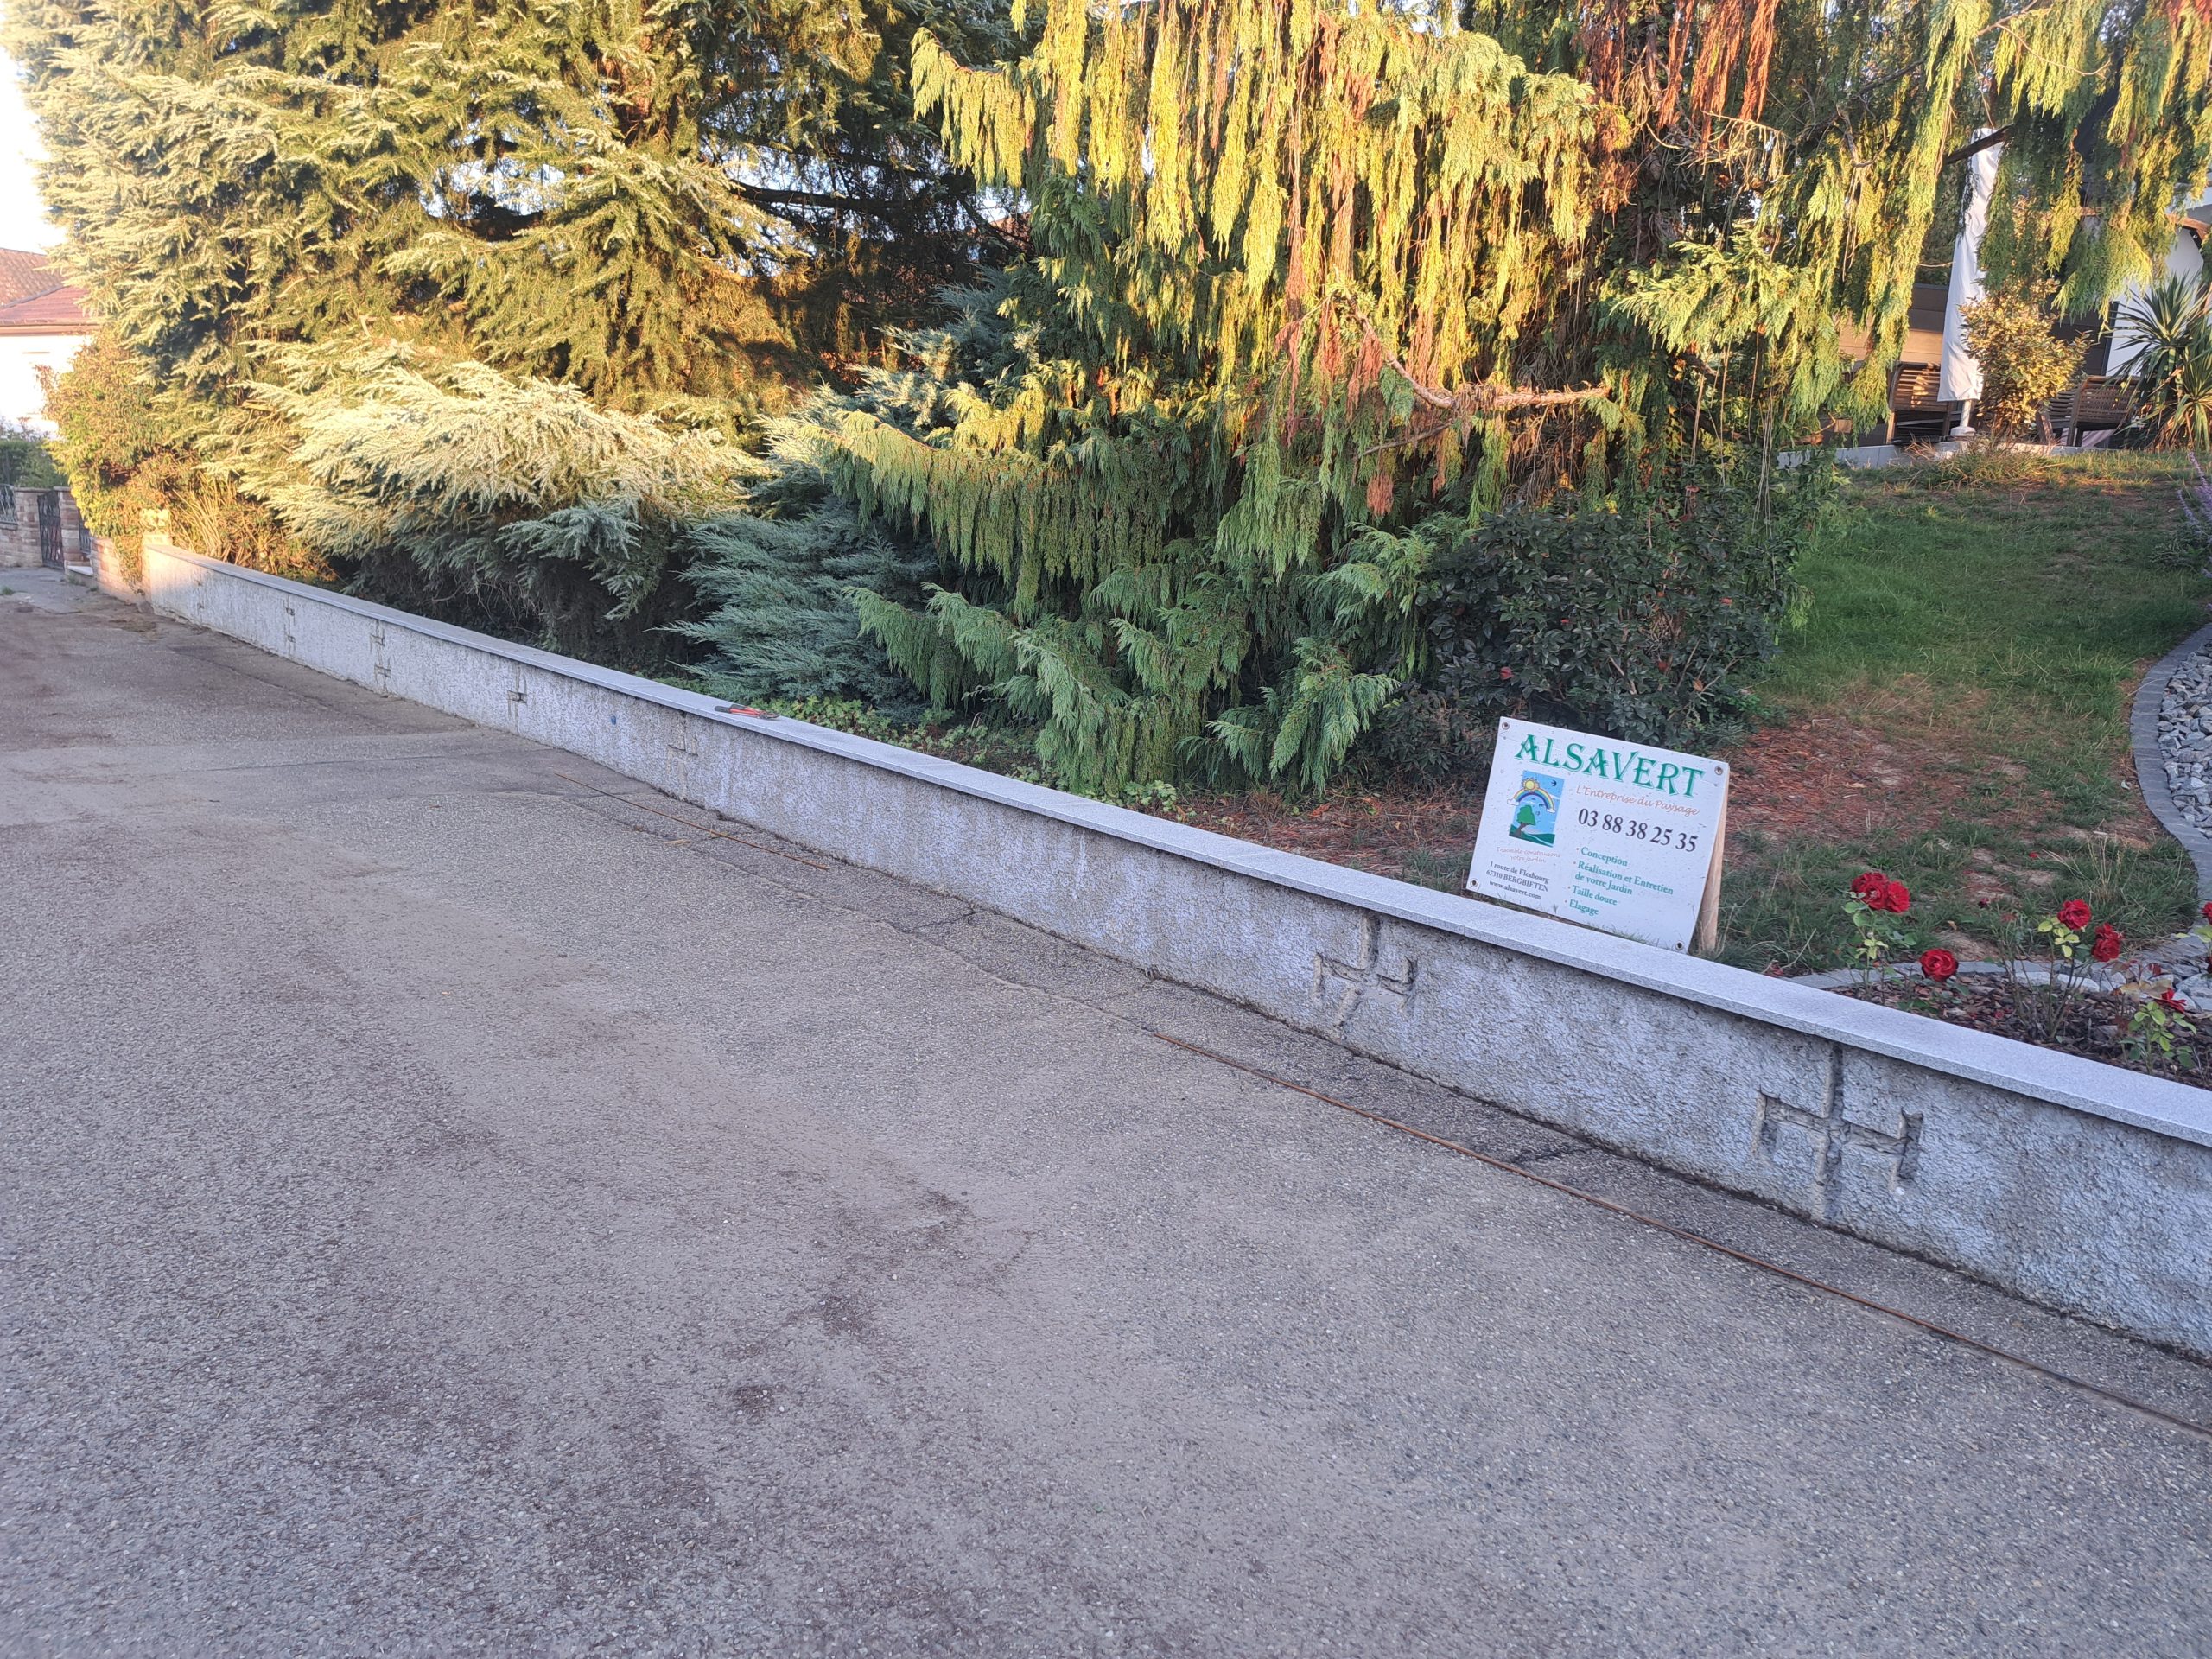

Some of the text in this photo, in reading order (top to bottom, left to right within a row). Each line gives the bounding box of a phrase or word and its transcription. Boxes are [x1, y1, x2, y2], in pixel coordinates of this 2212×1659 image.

[1515, 734, 1706, 798] ALSAVERT
[1576, 785, 1700, 817] L'Entreprise du Paysage
[1578, 808, 1699, 852] 03 88 38 25 35
[1494, 863, 1510, 872] route
[1580, 846, 1628, 866] Conception
[1485, 869, 1549, 892] 67310 BERGBIETEN
[1574, 872, 1633, 895] de votre Jardin
[1578, 860, 1623, 880] Réalisation
[1634, 875, 1674, 895] Entretien
[1489, 880, 1541, 899] www.alsavert.com
[1572, 885, 1618, 906] Taille douce
[1569, 899, 1599, 916] Elagage
